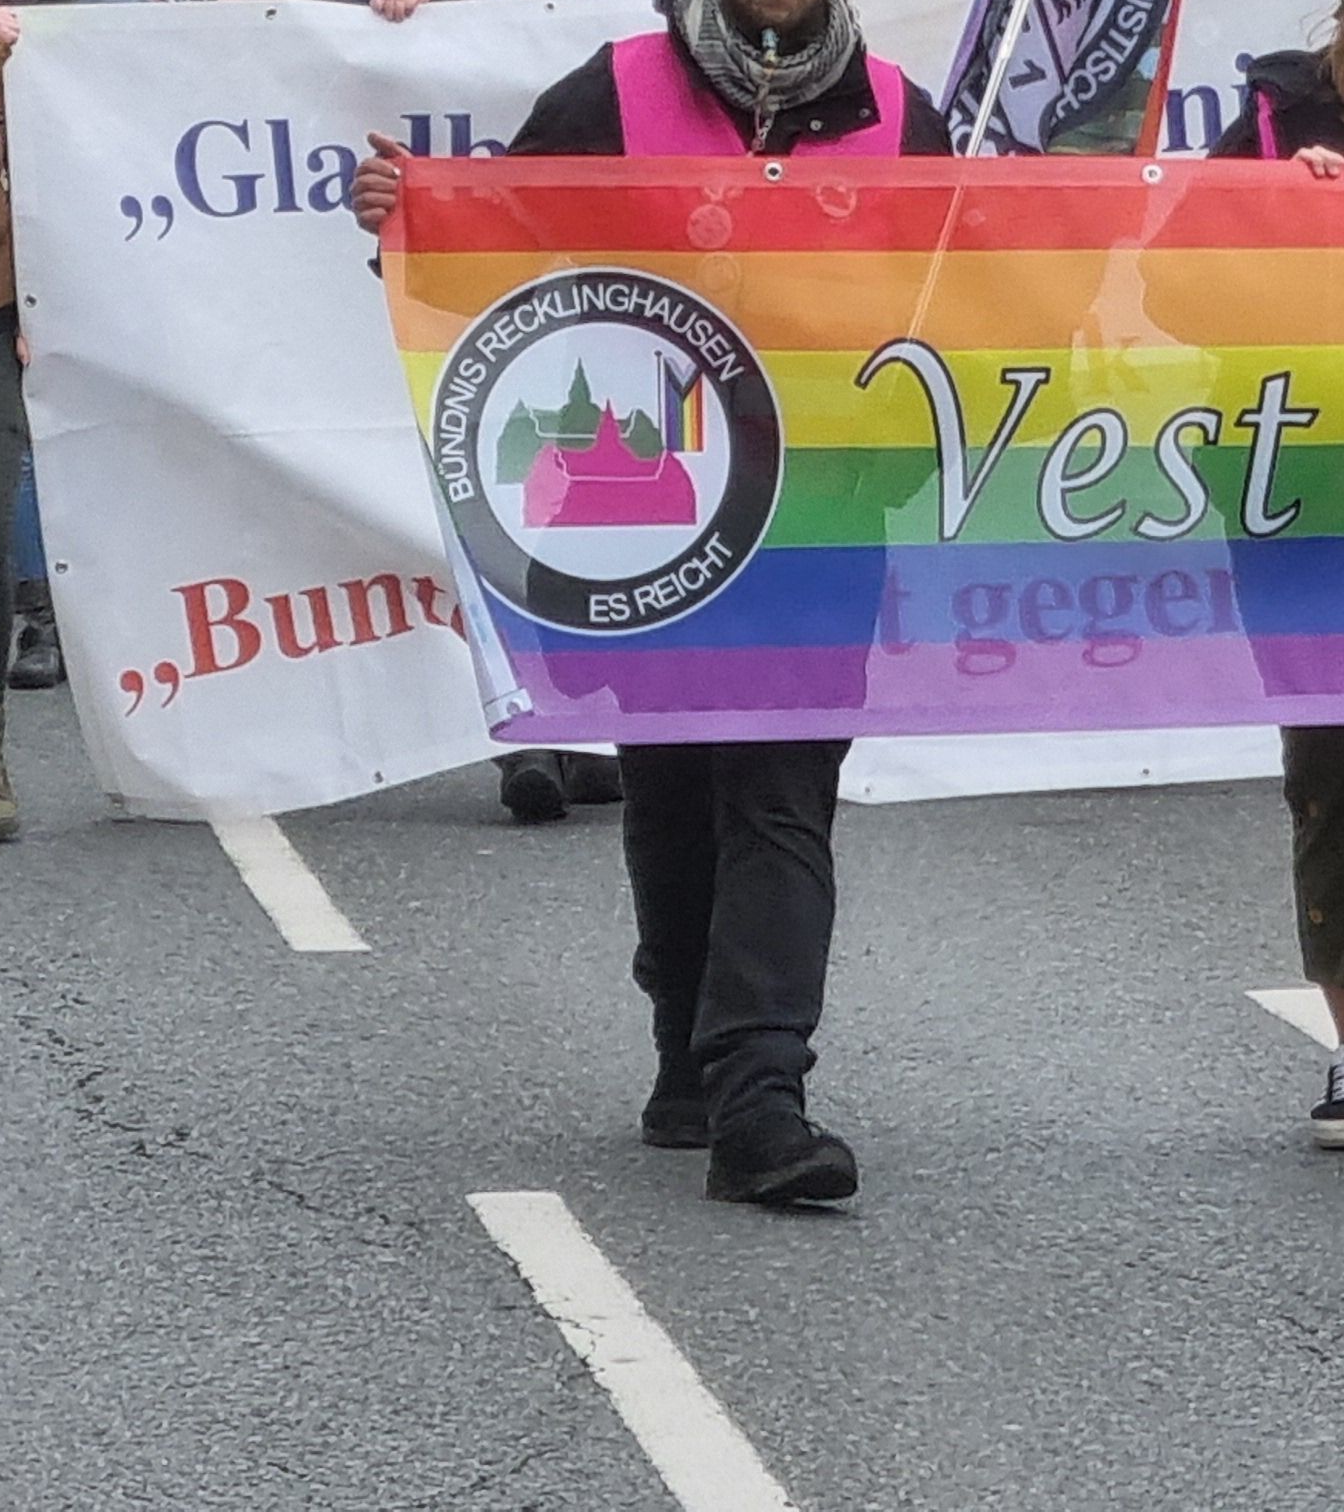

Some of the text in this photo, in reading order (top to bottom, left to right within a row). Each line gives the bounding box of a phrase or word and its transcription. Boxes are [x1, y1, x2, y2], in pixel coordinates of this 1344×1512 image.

[436, 283, 746, 505] BÜNDNIS RECKLINGHAUSEN
[855, 335, 1322, 544] Vest
[119, 566, 467, 718] „Bunt
[588, 531, 735, 624] ES REICHT
